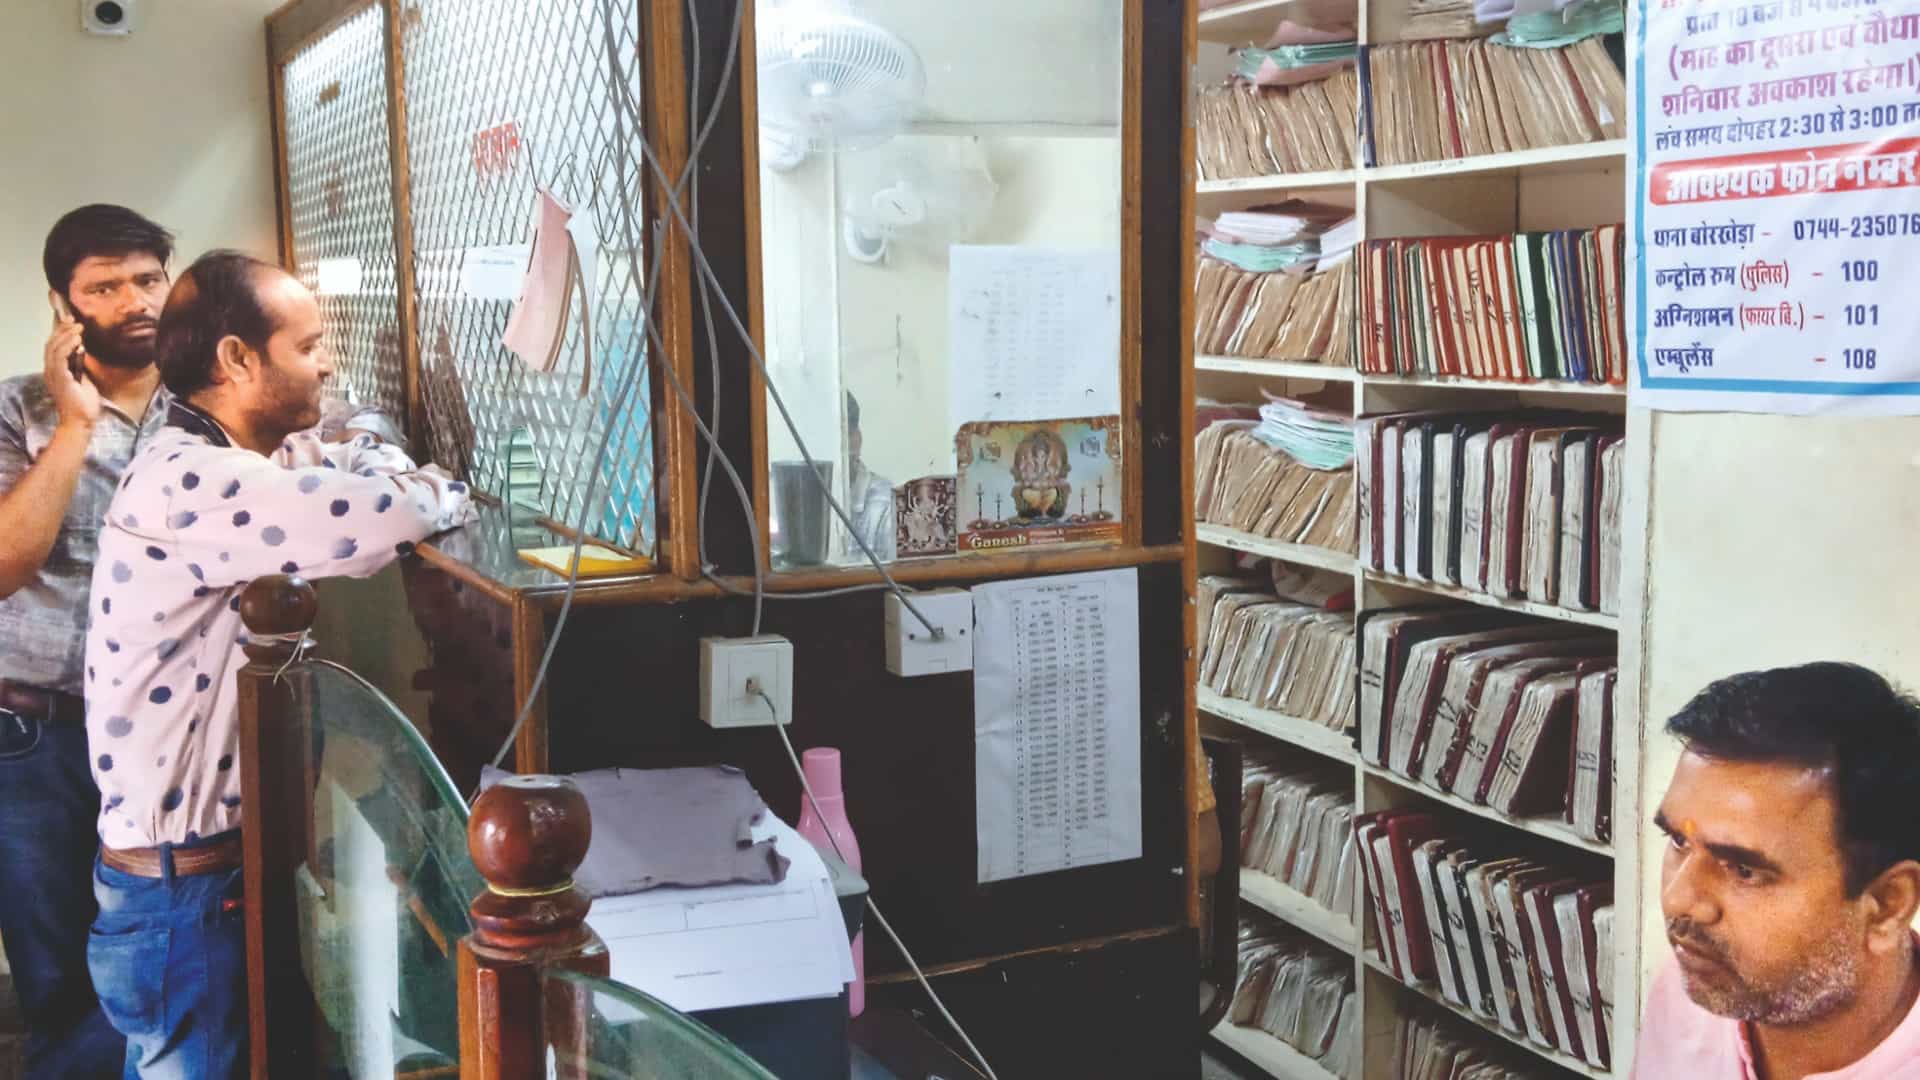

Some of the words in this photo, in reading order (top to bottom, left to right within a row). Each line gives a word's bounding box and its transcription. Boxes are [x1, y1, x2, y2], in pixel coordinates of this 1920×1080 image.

[1662, 84, 1740, 117] शनिवार
[1748, 72, 1836, 107] अवकाश
[1655, 125, 1682, 151] लंच
[1685, 125, 1725, 147] समय
[1727, 117, 1776, 143] दोपहर
[1780, 112, 1824, 138] 2:30
[1829, 105, 1845, 133] से
[1850, 104, 1898, 130] 3:00
[1903, 102, 1920, 123] त
[1781, 151, 1838, 195] फोन
[1793, 213, 1920, 241] 0744-235076
[1740, 259, 1789, 292] (पुलिस)
[1841, 260, 1878, 282] 100
[1654, 303, 1735, 327] अग्निशमन
[1739, 303, 1776, 331] (फायर
[1844, 304, 1879, 326] 101
[1843, 348, 1877, 370] 108
